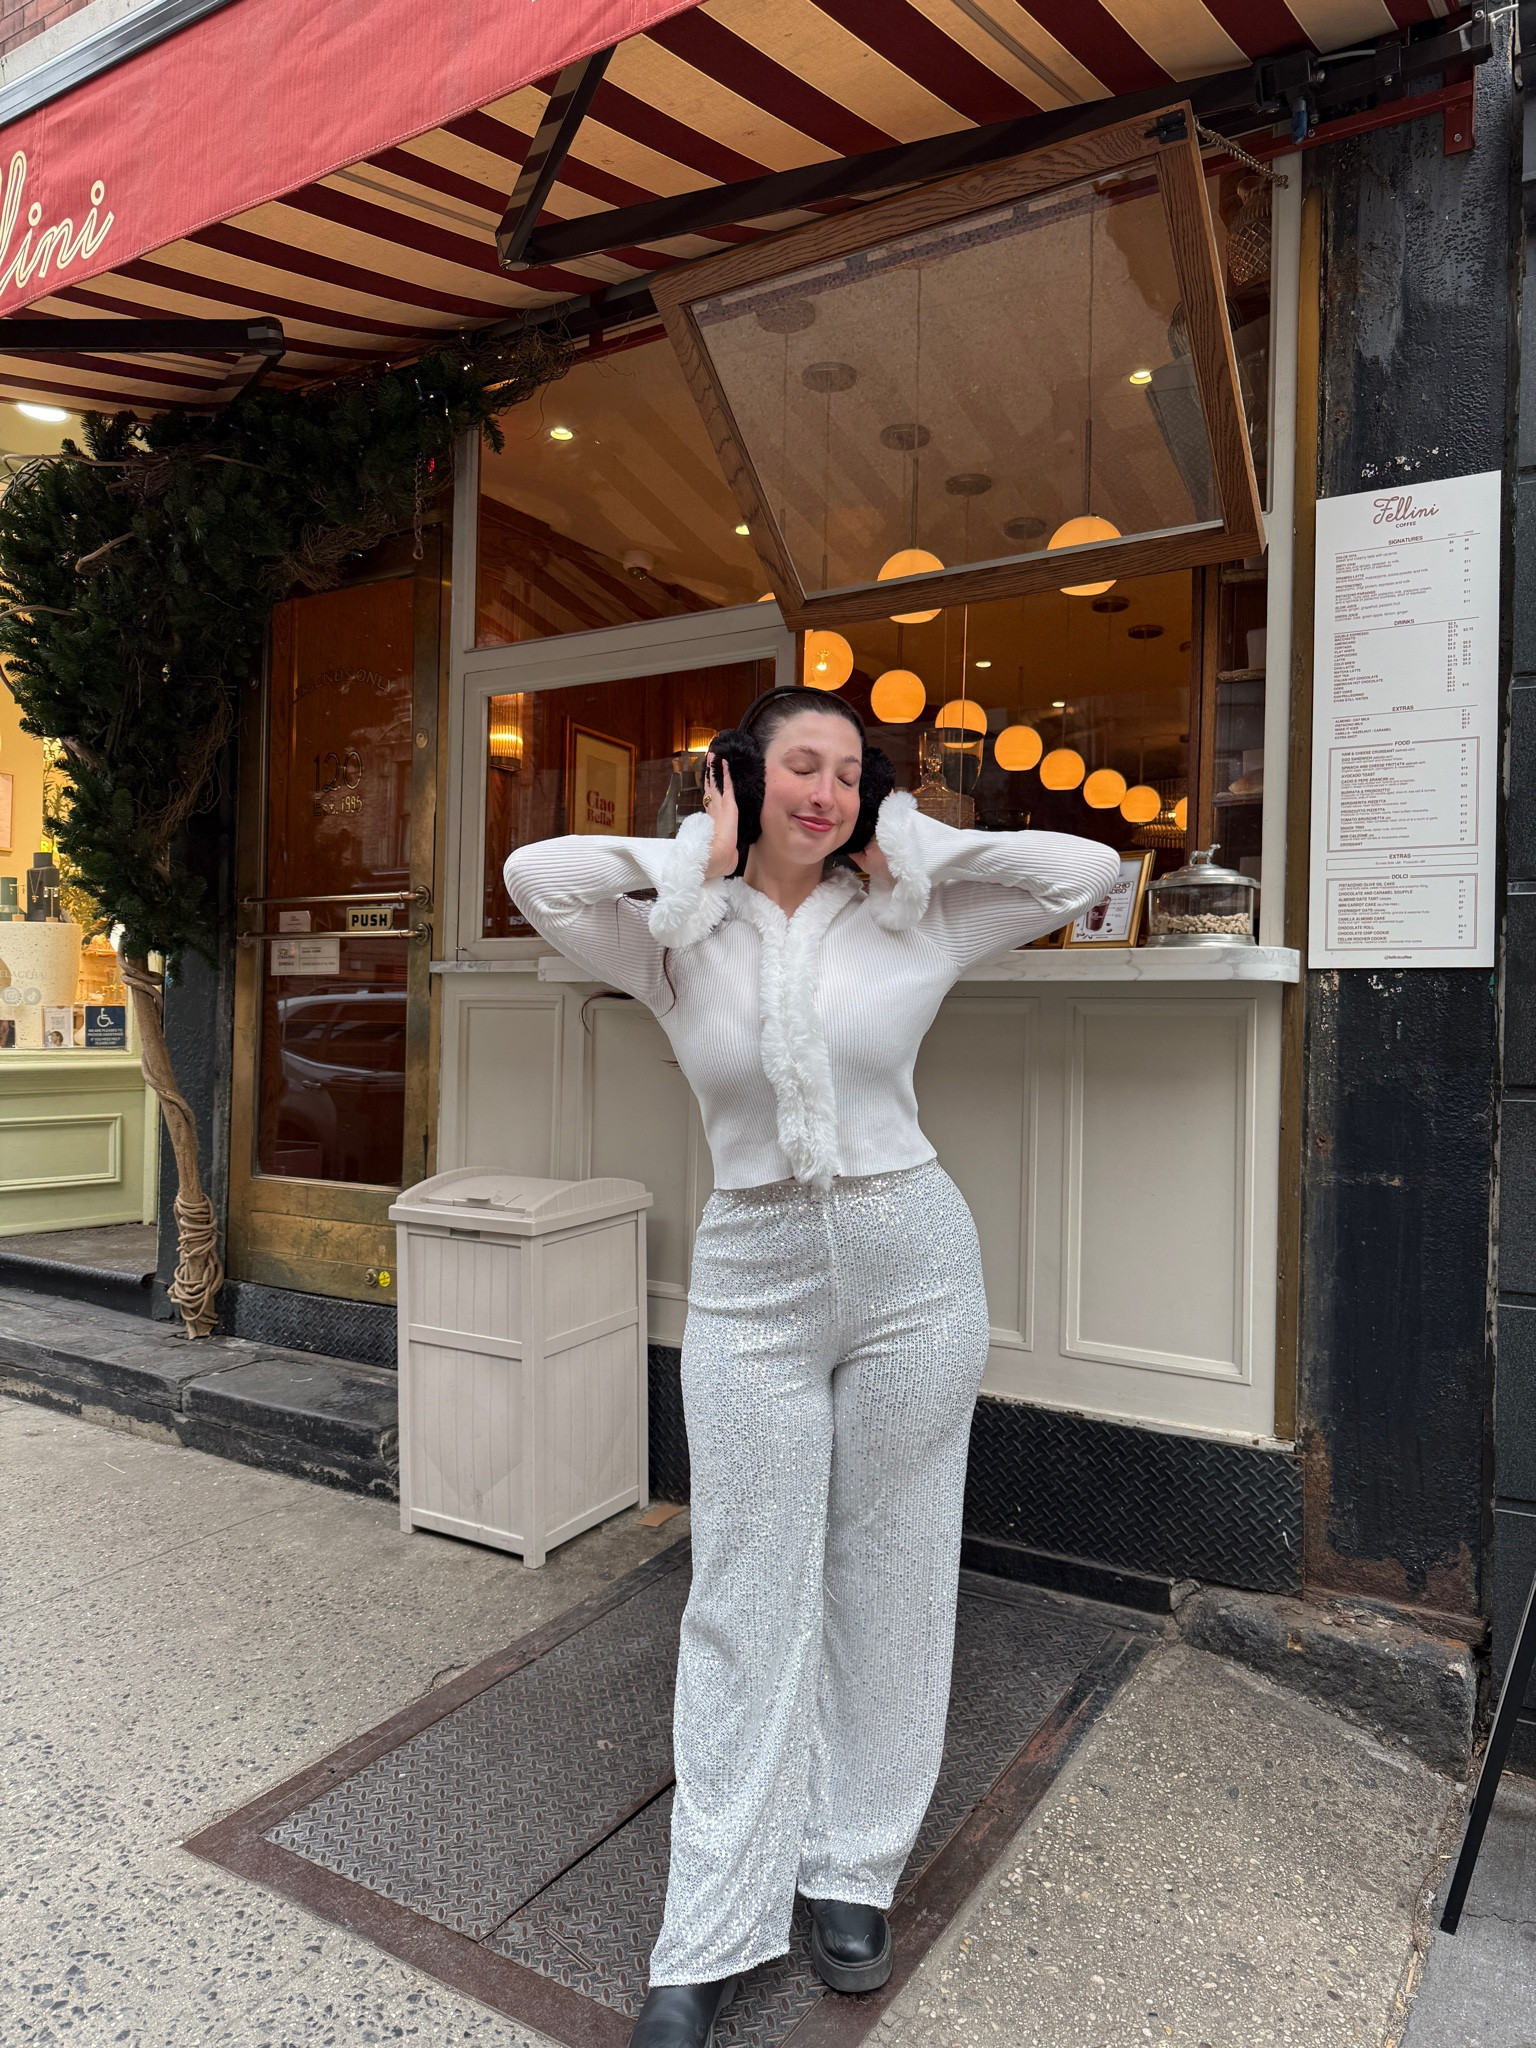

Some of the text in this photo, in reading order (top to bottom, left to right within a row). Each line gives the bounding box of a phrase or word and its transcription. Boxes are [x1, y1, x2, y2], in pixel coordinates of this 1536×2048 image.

[1373, 496, 1439, 524] Fellini
[1388, 536, 1423, 545] SIGNATURES
[315, 751, 363, 794] 120
[313, 796, 363, 817] Est. 1995
[586, 789, 616, 814] Ciao
[587, 808, 616, 828] Bella!
[351, 913, 387, 927] PUSH
